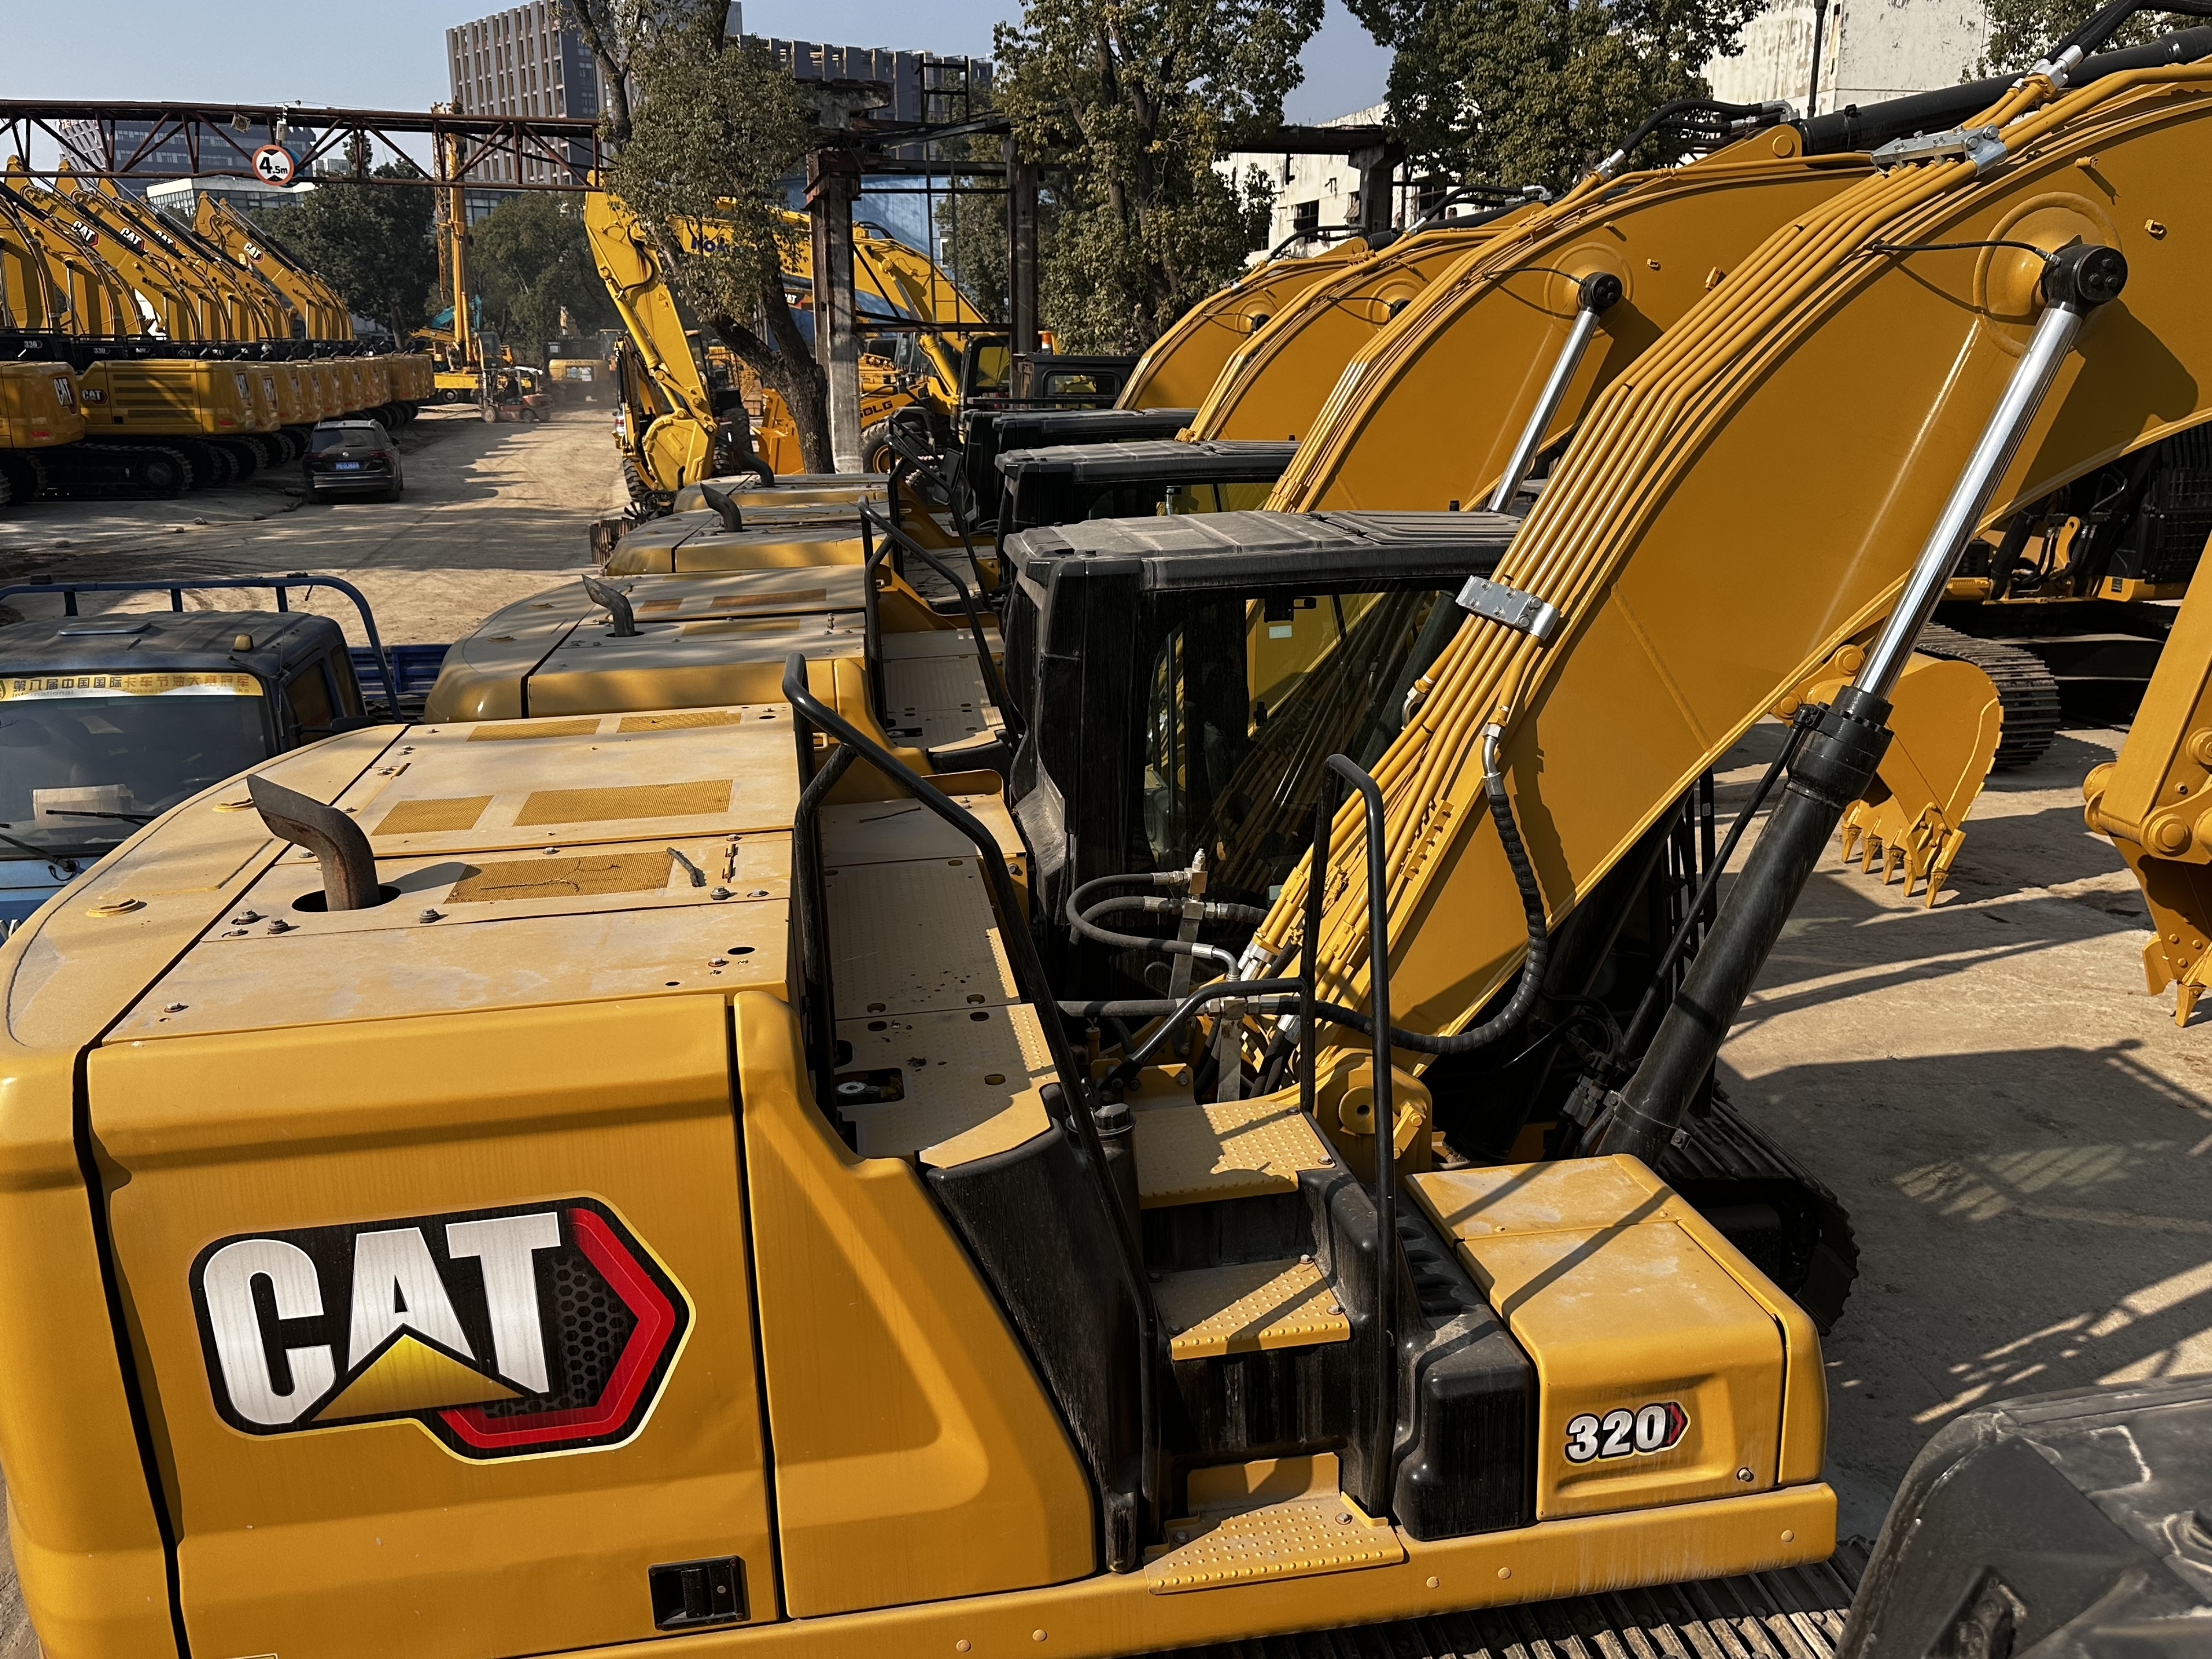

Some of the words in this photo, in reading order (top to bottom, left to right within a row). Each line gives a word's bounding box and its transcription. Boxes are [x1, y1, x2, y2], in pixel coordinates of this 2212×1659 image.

[259, 156, 288, 174] 4.5m
[71, 220, 95, 241] CAT
[120, 227, 142, 244] CAT
[243, 242, 262, 258] CAT
[785, 293, 797, 304] AT
[53, 378, 73, 407] CAT
[82, 389, 101, 401] CAT
[202, 1211, 561, 1426] CAT
[1567, 1404, 1667, 1460] 320
